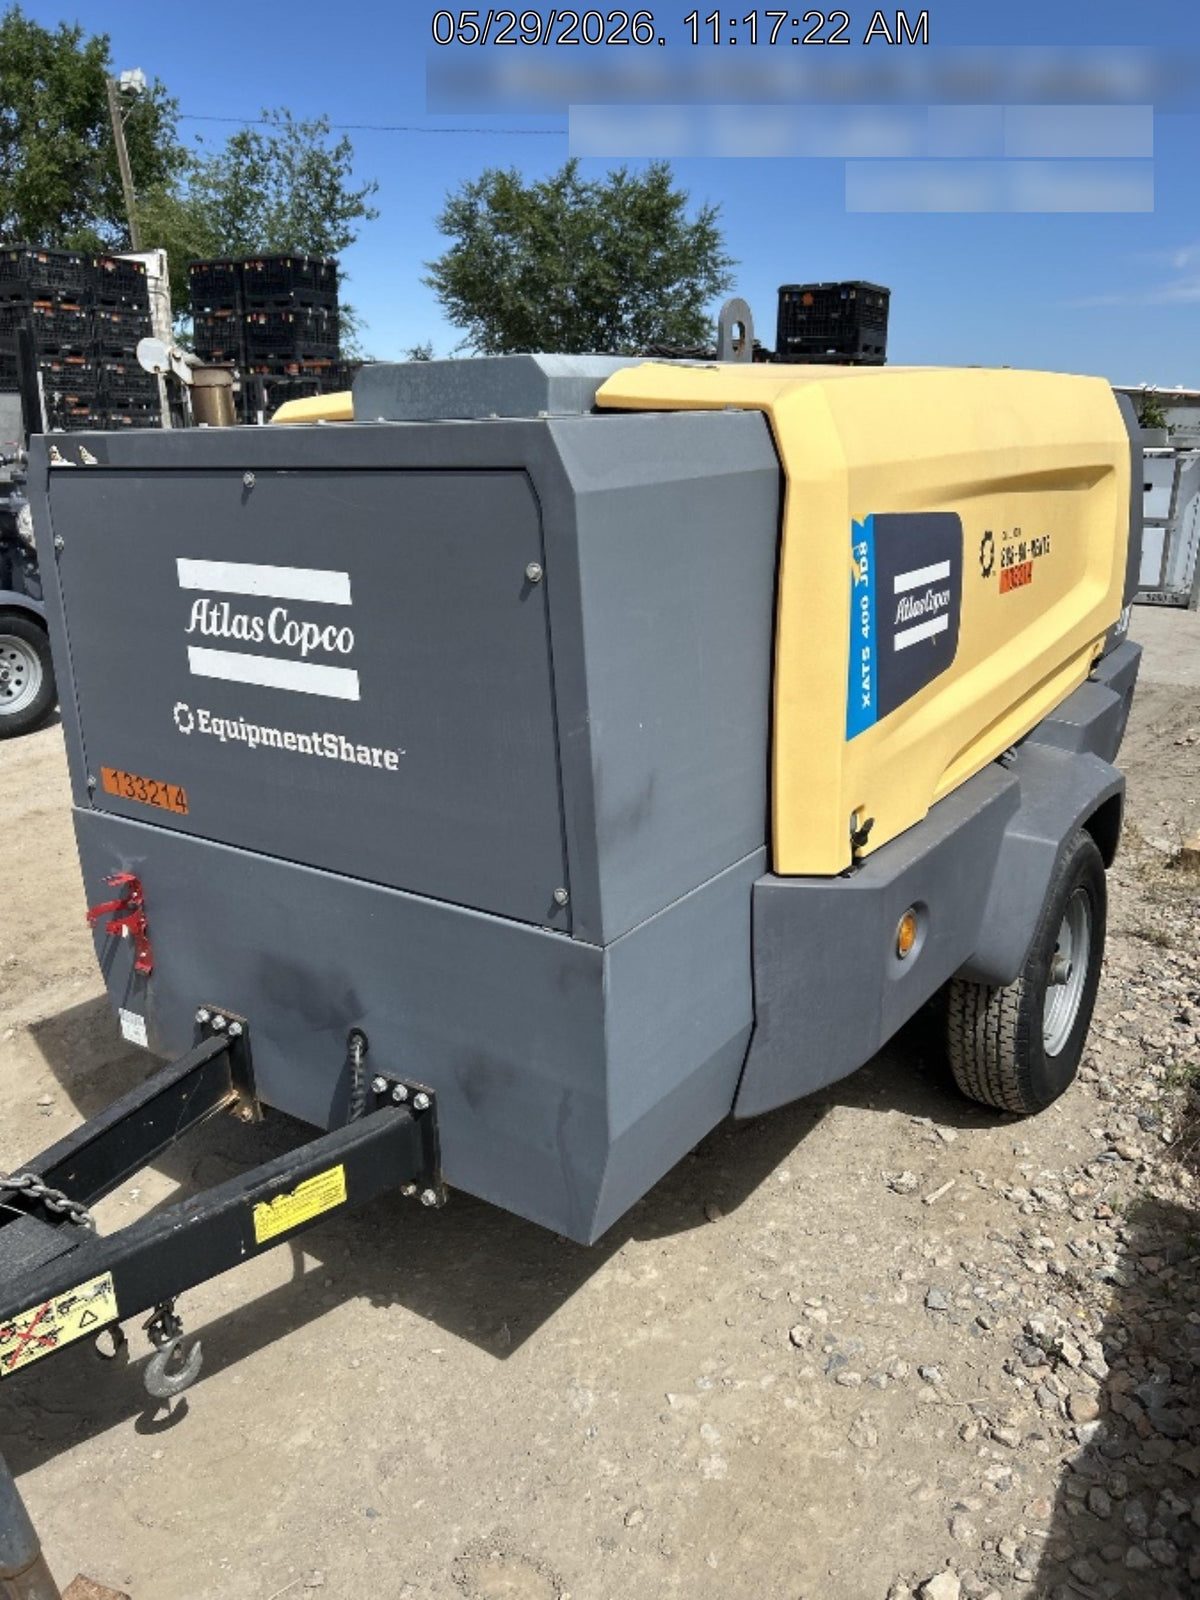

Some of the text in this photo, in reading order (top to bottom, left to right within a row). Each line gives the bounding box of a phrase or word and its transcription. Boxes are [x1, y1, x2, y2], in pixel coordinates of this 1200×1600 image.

[185, 599, 354, 657] Atlas Copco
[860, 595, 869, 639] 400
[861, 646, 871, 710] XATS
[197, 709, 399, 771] EquipmentShare
[111, 771, 186, 812] 133214
